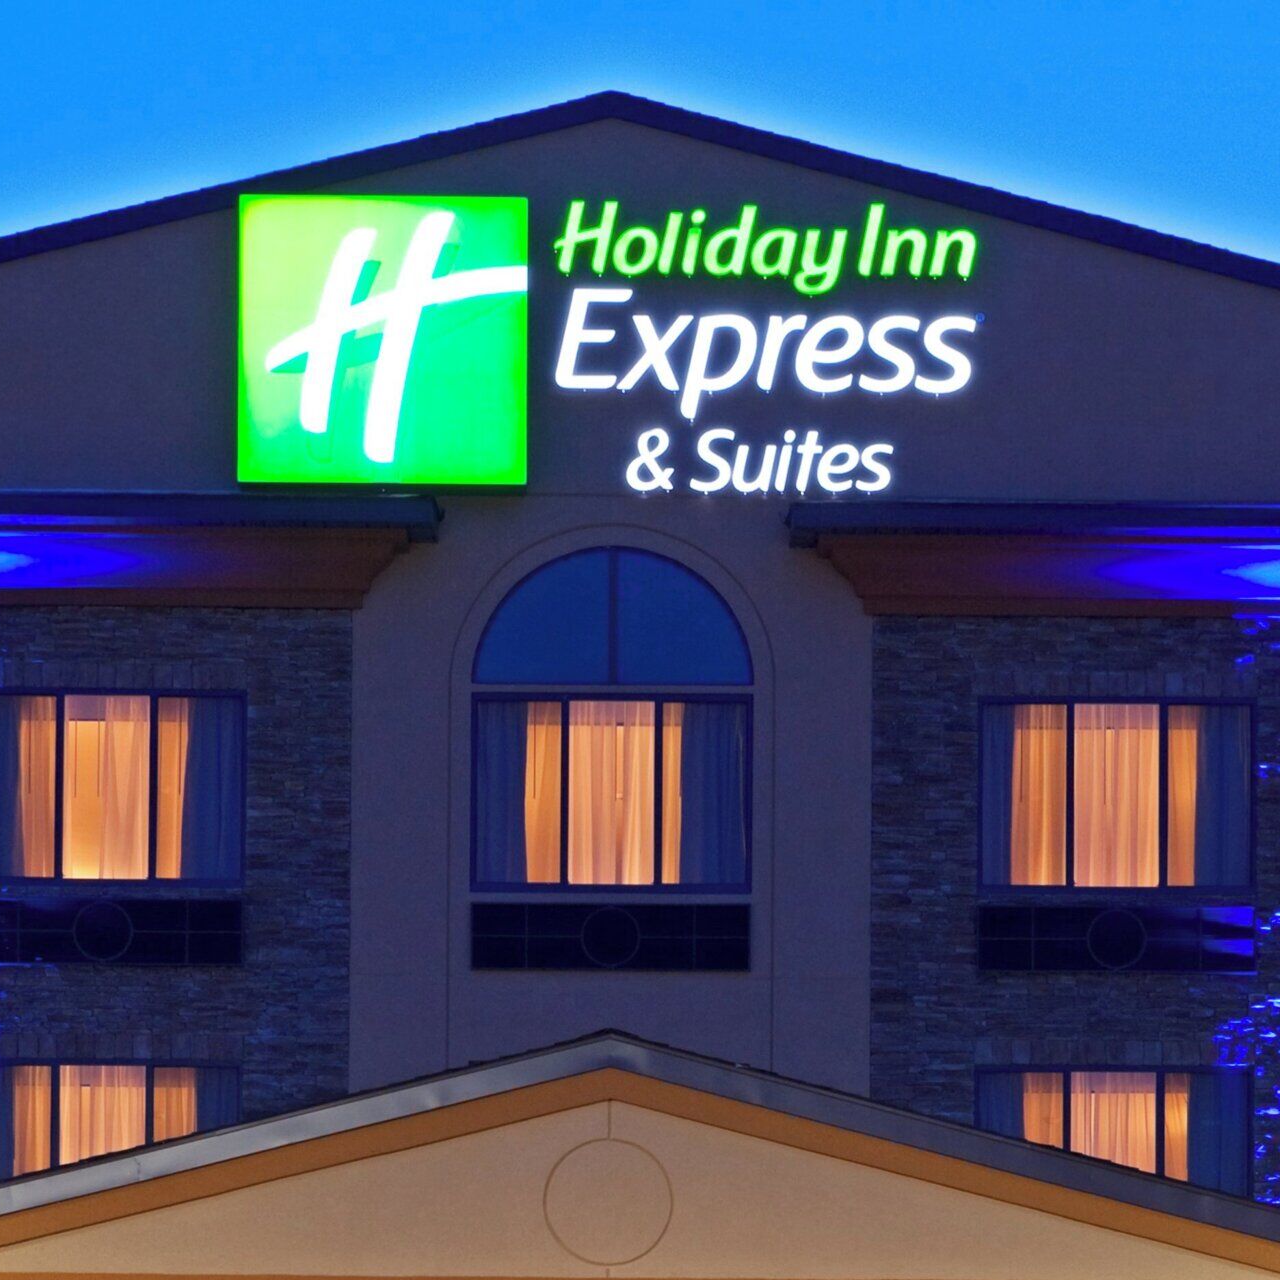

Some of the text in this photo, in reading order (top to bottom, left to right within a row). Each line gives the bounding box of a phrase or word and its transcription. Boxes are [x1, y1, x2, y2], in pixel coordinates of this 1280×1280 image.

[553, 200, 977, 294] Holiday Inn
[264, 210, 527, 463] H
[554, 287, 976, 421] Express
[625, 427, 894, 493] & Suites
